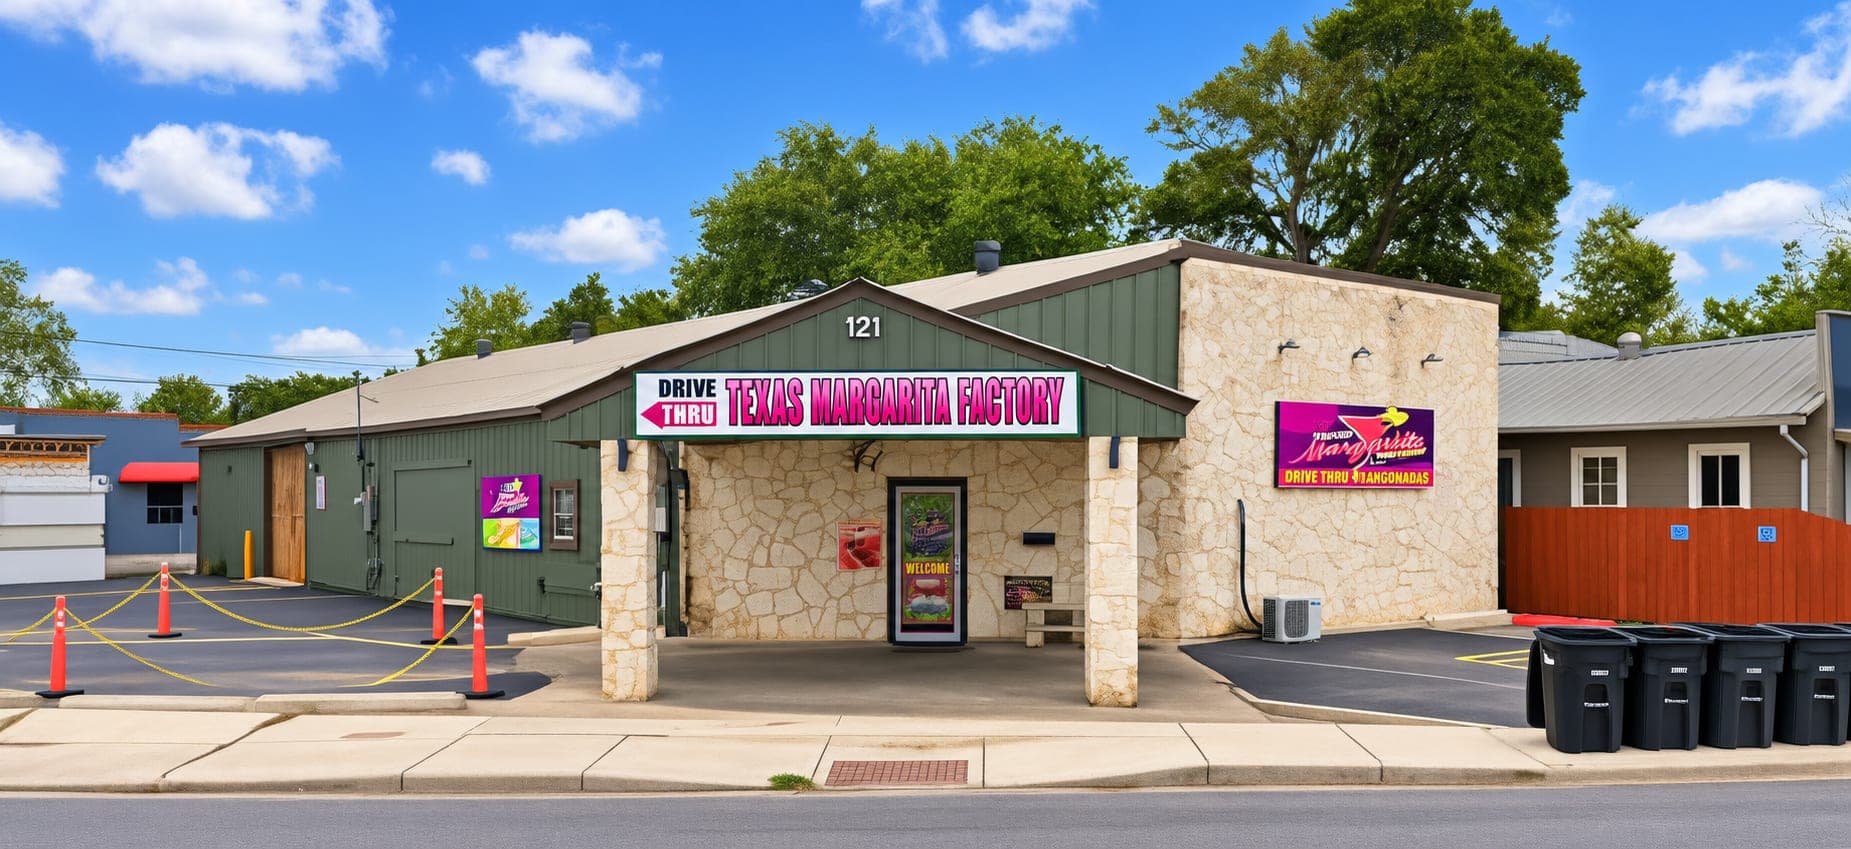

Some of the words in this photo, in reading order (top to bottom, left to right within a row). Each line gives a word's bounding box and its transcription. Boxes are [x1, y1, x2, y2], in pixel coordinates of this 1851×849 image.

[845, 316, 881, 338] 121
[658, 378, 717, 398] DRIVE
[725, 377, 804, 427] TEXAS
[810, 377, 952, 426] MARGARITA
[957, 376, 1065, 425] FACTORY
[661, 404, 715, 425] THRU
[1285, 469, 1318, 484] DRIVE
[1320, 470, 1349, 485] THRU
[905, 562, 951, 575] WELCOME
